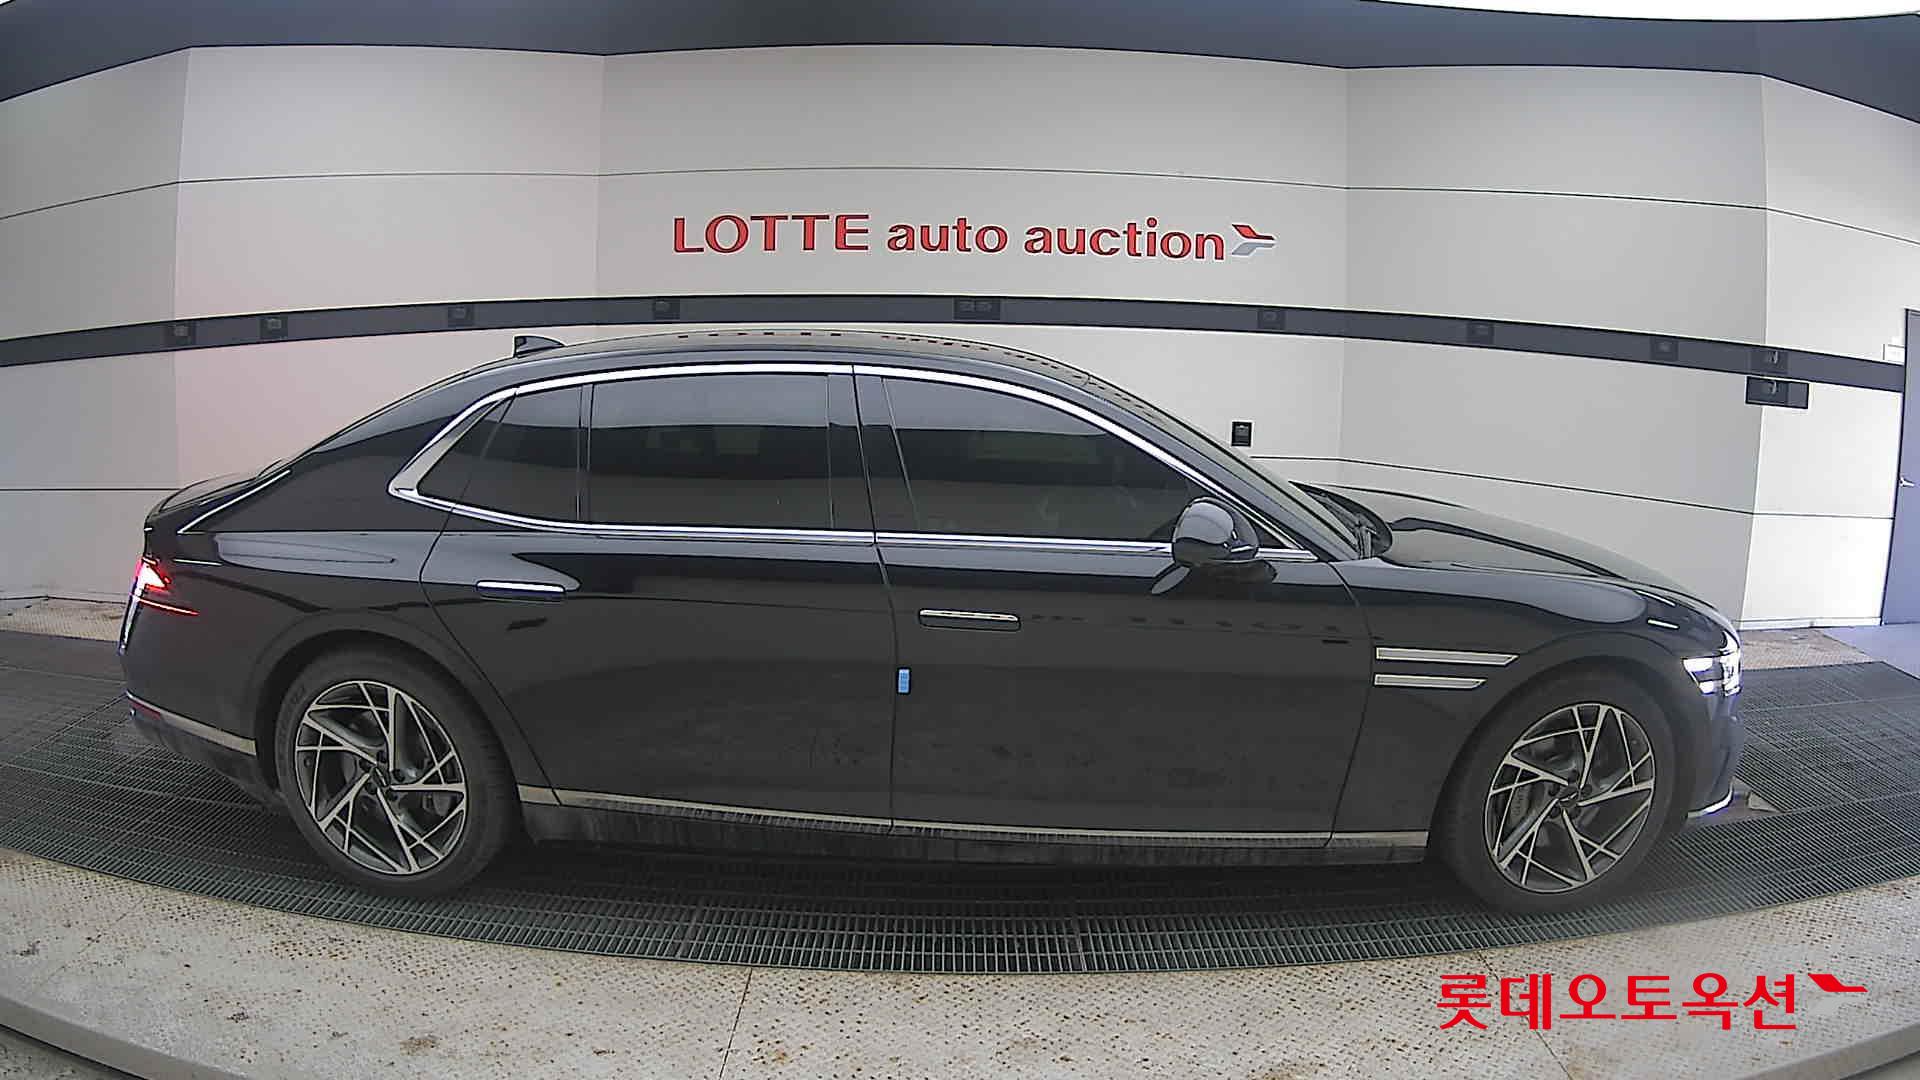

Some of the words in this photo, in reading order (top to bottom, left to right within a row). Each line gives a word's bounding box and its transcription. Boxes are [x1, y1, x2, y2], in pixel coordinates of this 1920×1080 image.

[673, 214, 869, 253] LOTTE
[887, 217, 1009, 253] auto
[1024, 217, 1226, 260] auction
